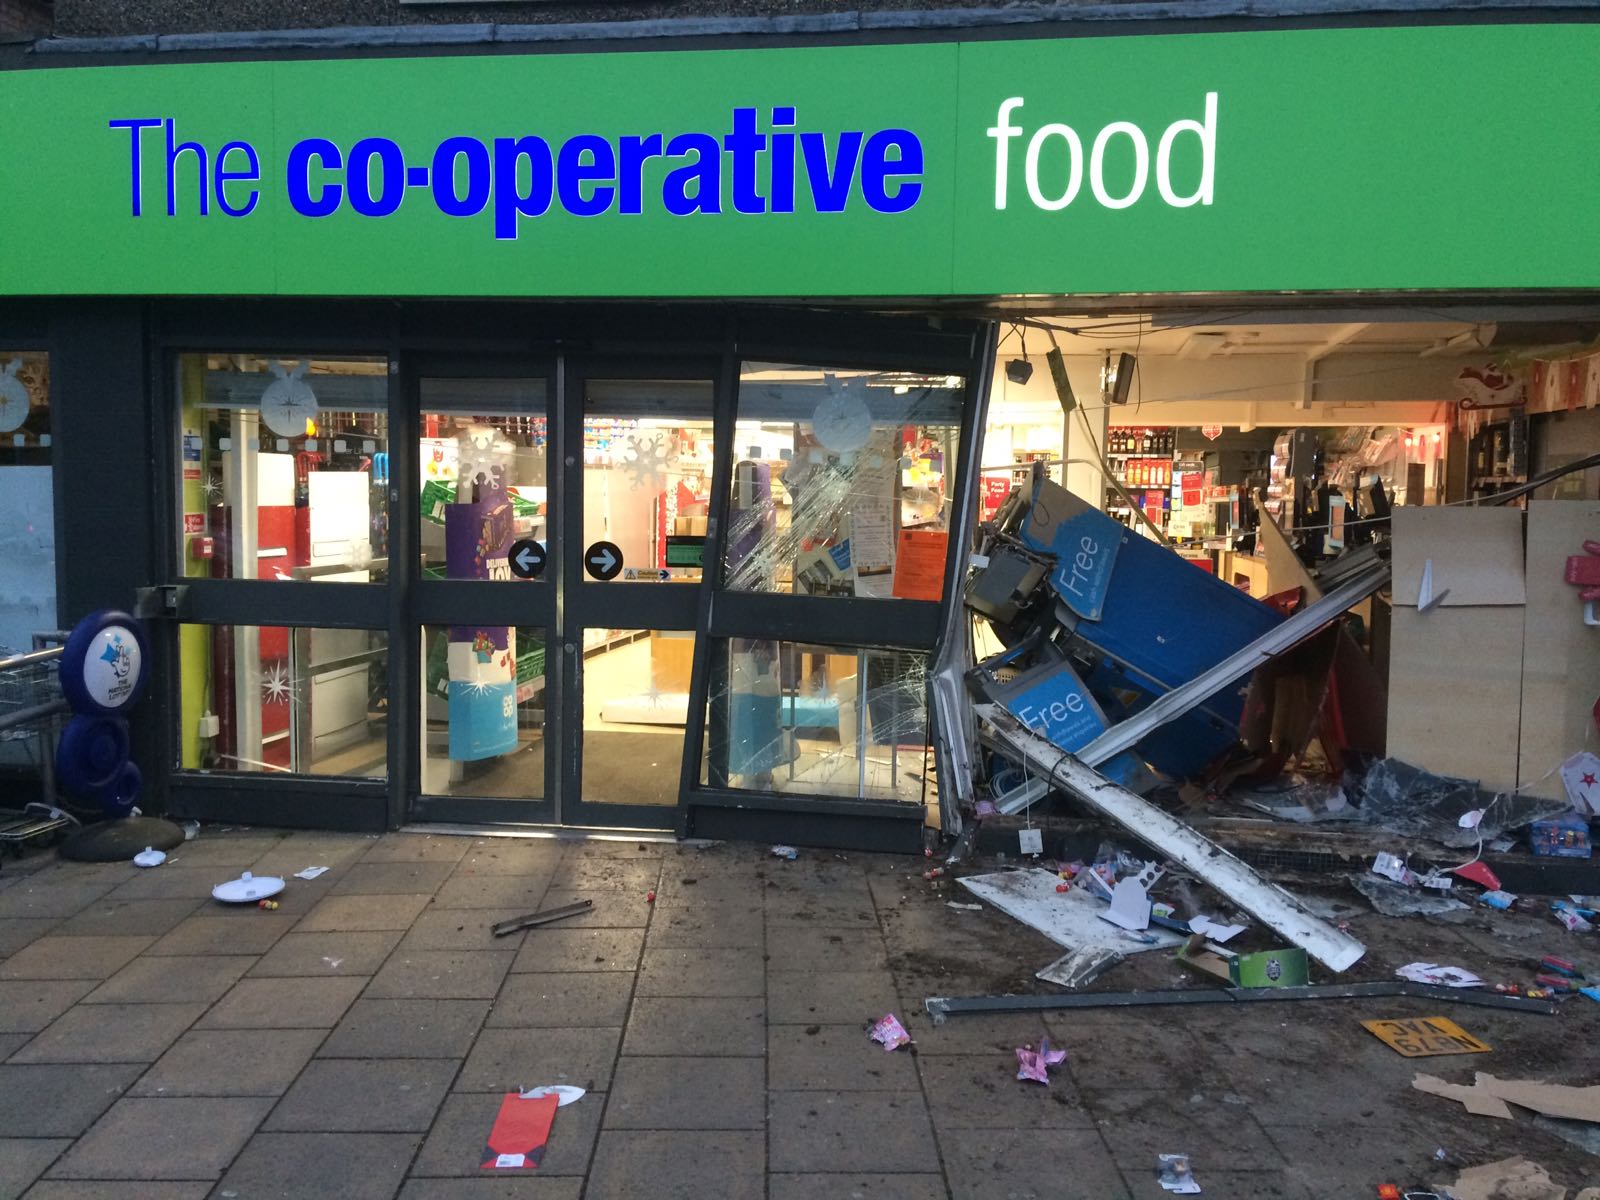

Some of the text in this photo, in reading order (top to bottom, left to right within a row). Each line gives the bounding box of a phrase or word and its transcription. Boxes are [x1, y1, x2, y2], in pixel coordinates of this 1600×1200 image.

[109, 91, 1218, 240] The co-operative food
[990, 481, 1005, 489] Party
[1059, 536, 1098, 597] Free
[1020, 692, 1084, 729] Free
